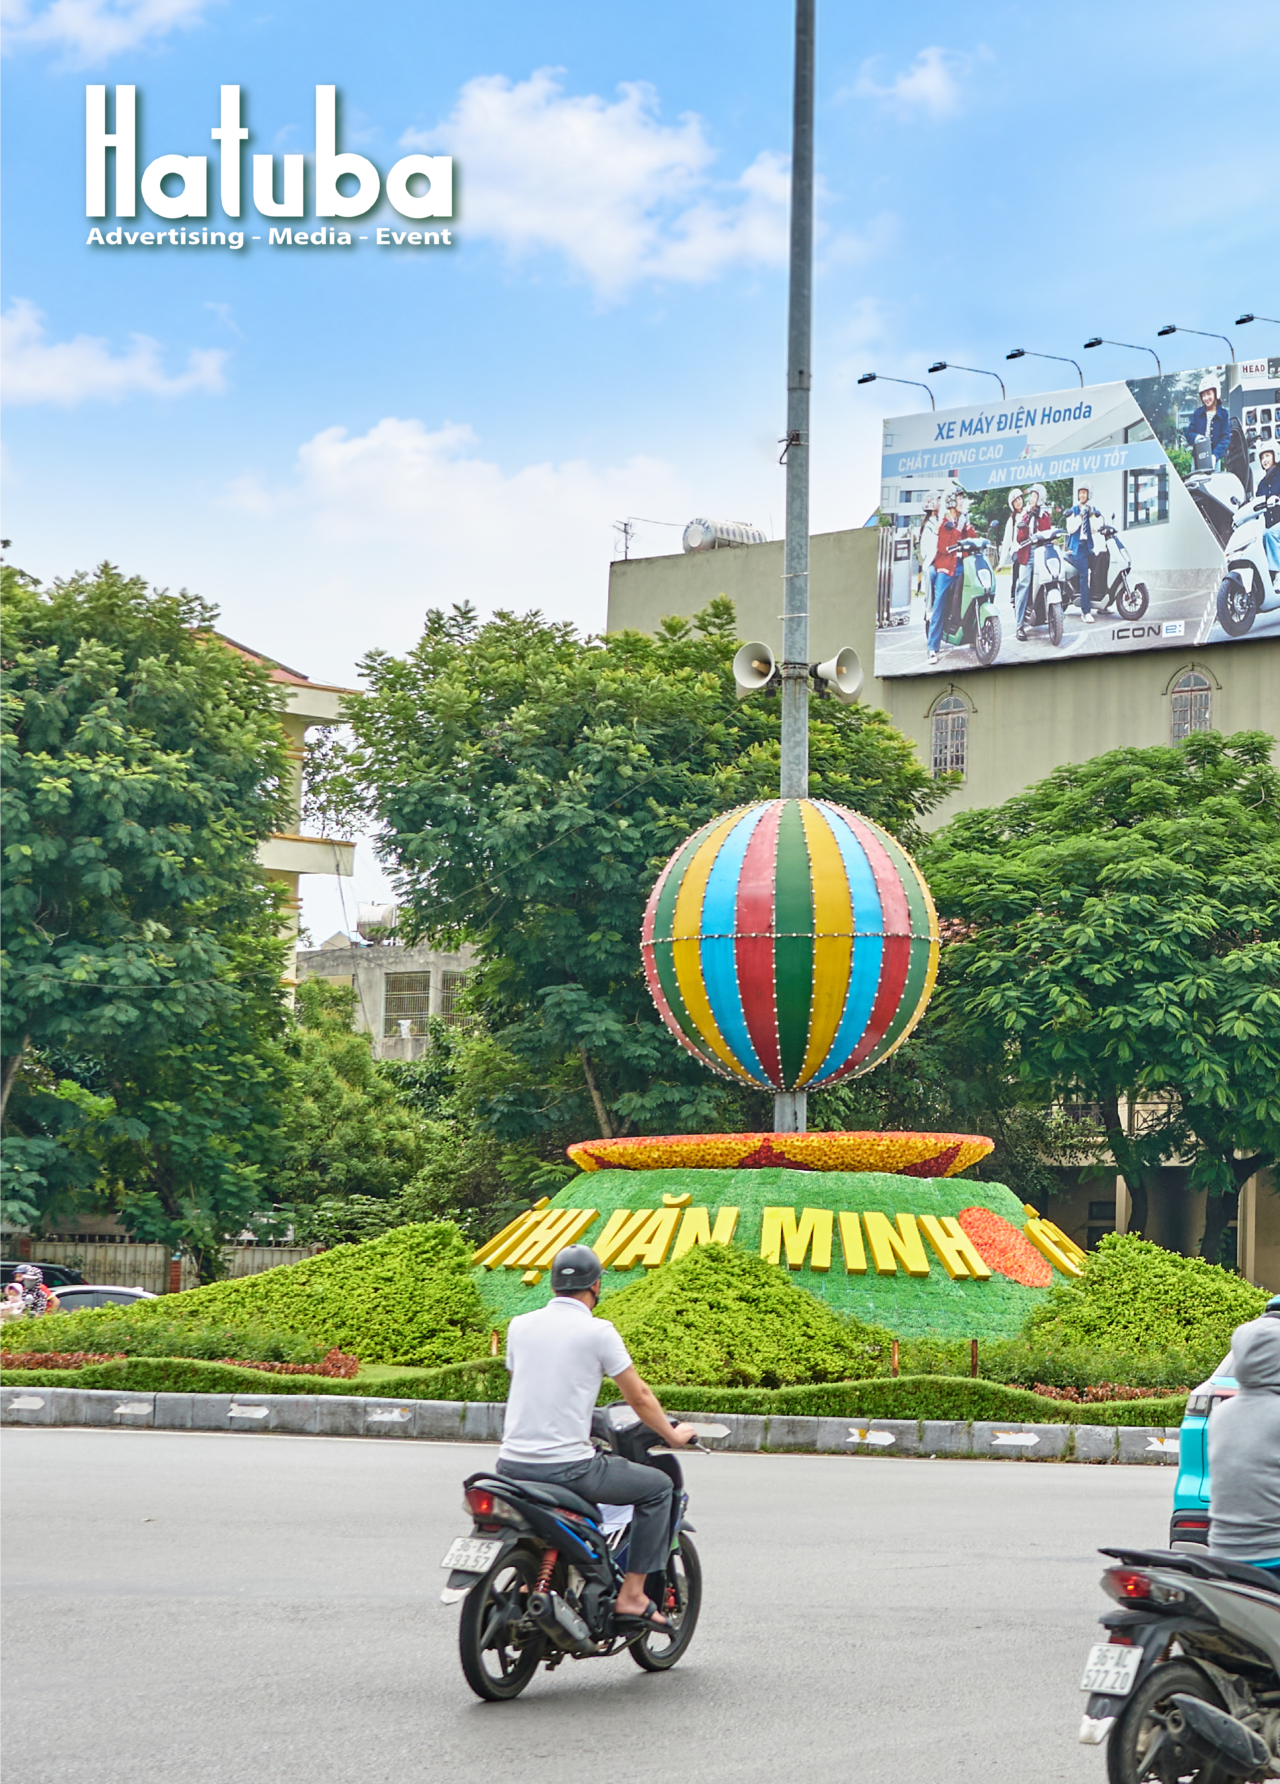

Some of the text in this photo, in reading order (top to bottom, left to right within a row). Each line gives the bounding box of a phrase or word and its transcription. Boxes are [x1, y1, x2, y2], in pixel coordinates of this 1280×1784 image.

[1242, 364, 1265, 373] HEAD
[934, 401, 1092, 441] XE MÁY ĐIỆN Honda
[898, 444, 1003, 472] CHẤT LƯỢNG CAO
[988, 447, 1129, 484] AN TOÀN, DỊCH VỤ TỐT
[1112, 625, 1161, 640] ICON
[591, 1193, 739, 1272] VĂN
[760, 1206, 992, 1280] MINH
